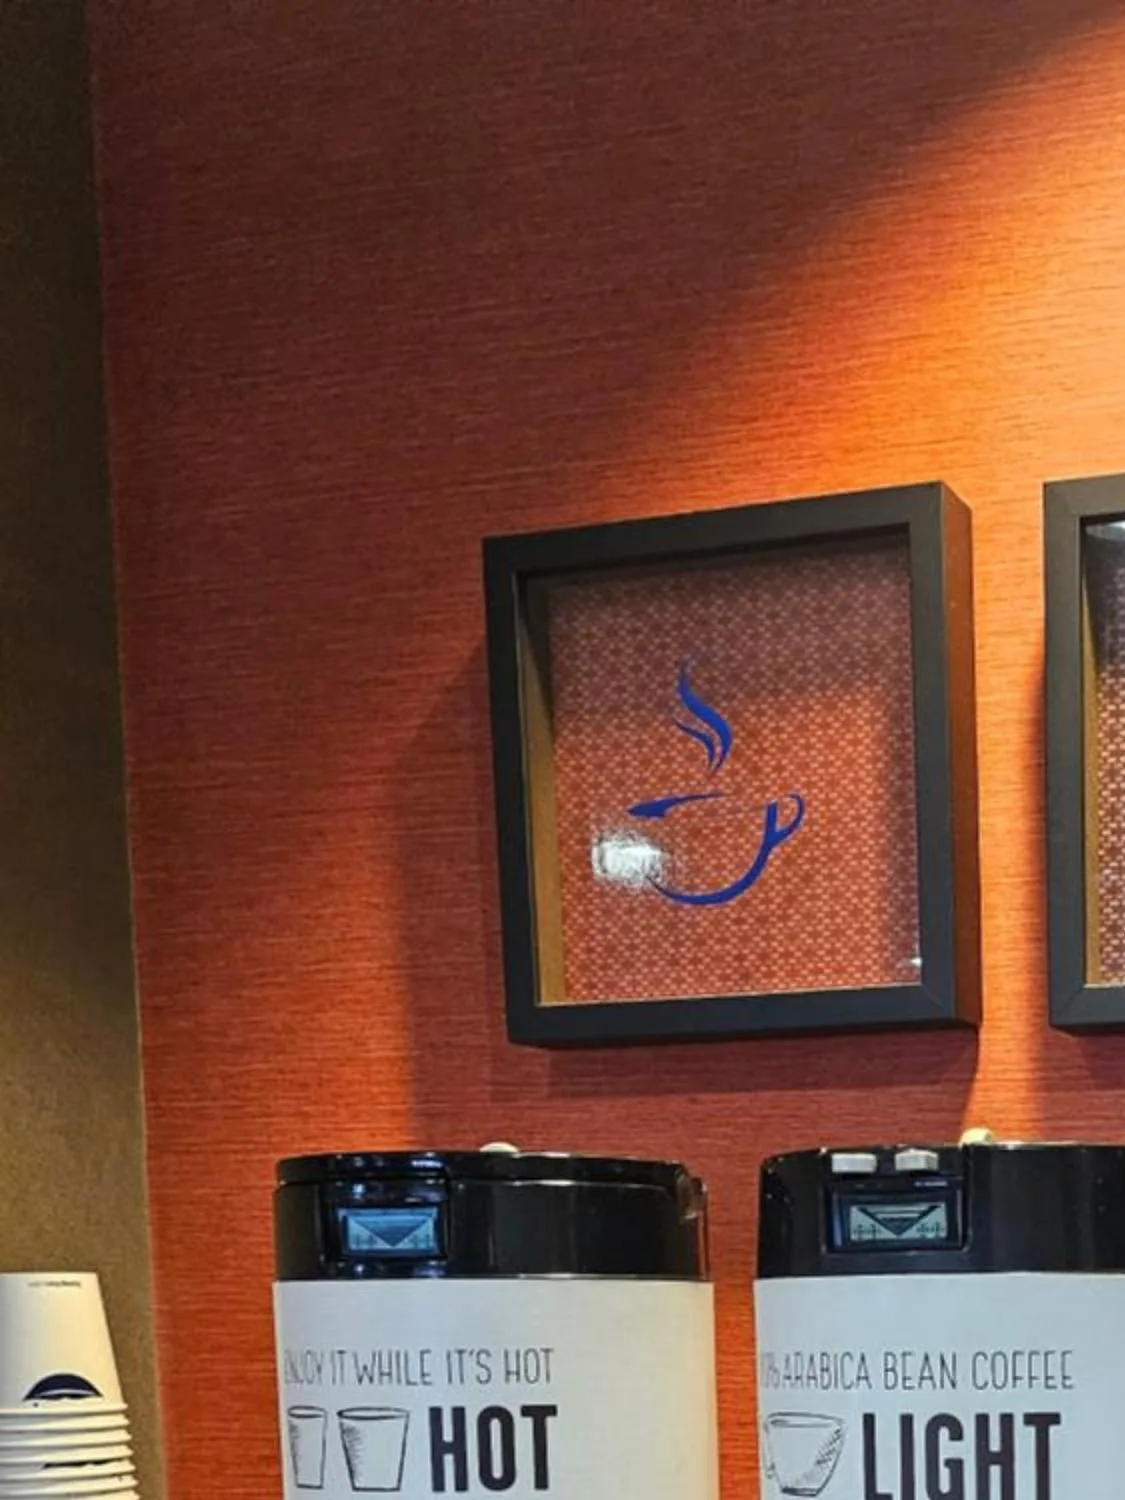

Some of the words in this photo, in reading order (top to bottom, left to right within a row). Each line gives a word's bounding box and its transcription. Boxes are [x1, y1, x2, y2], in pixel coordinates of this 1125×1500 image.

[329, 1348, 347, 1386] IT
[353, 1348, 432, 1387] WHILE
[446, 1347, 492, 1385] IT'S
[504, 1346, 555, 1385] HOT
[781, 1350, 872, 1391] ARABICA
[883, 1350, 958, 1391] BEAN
[972, 1350, 1075, 1391] COFFEE
[428, 1404, 558, 1493] HOT
